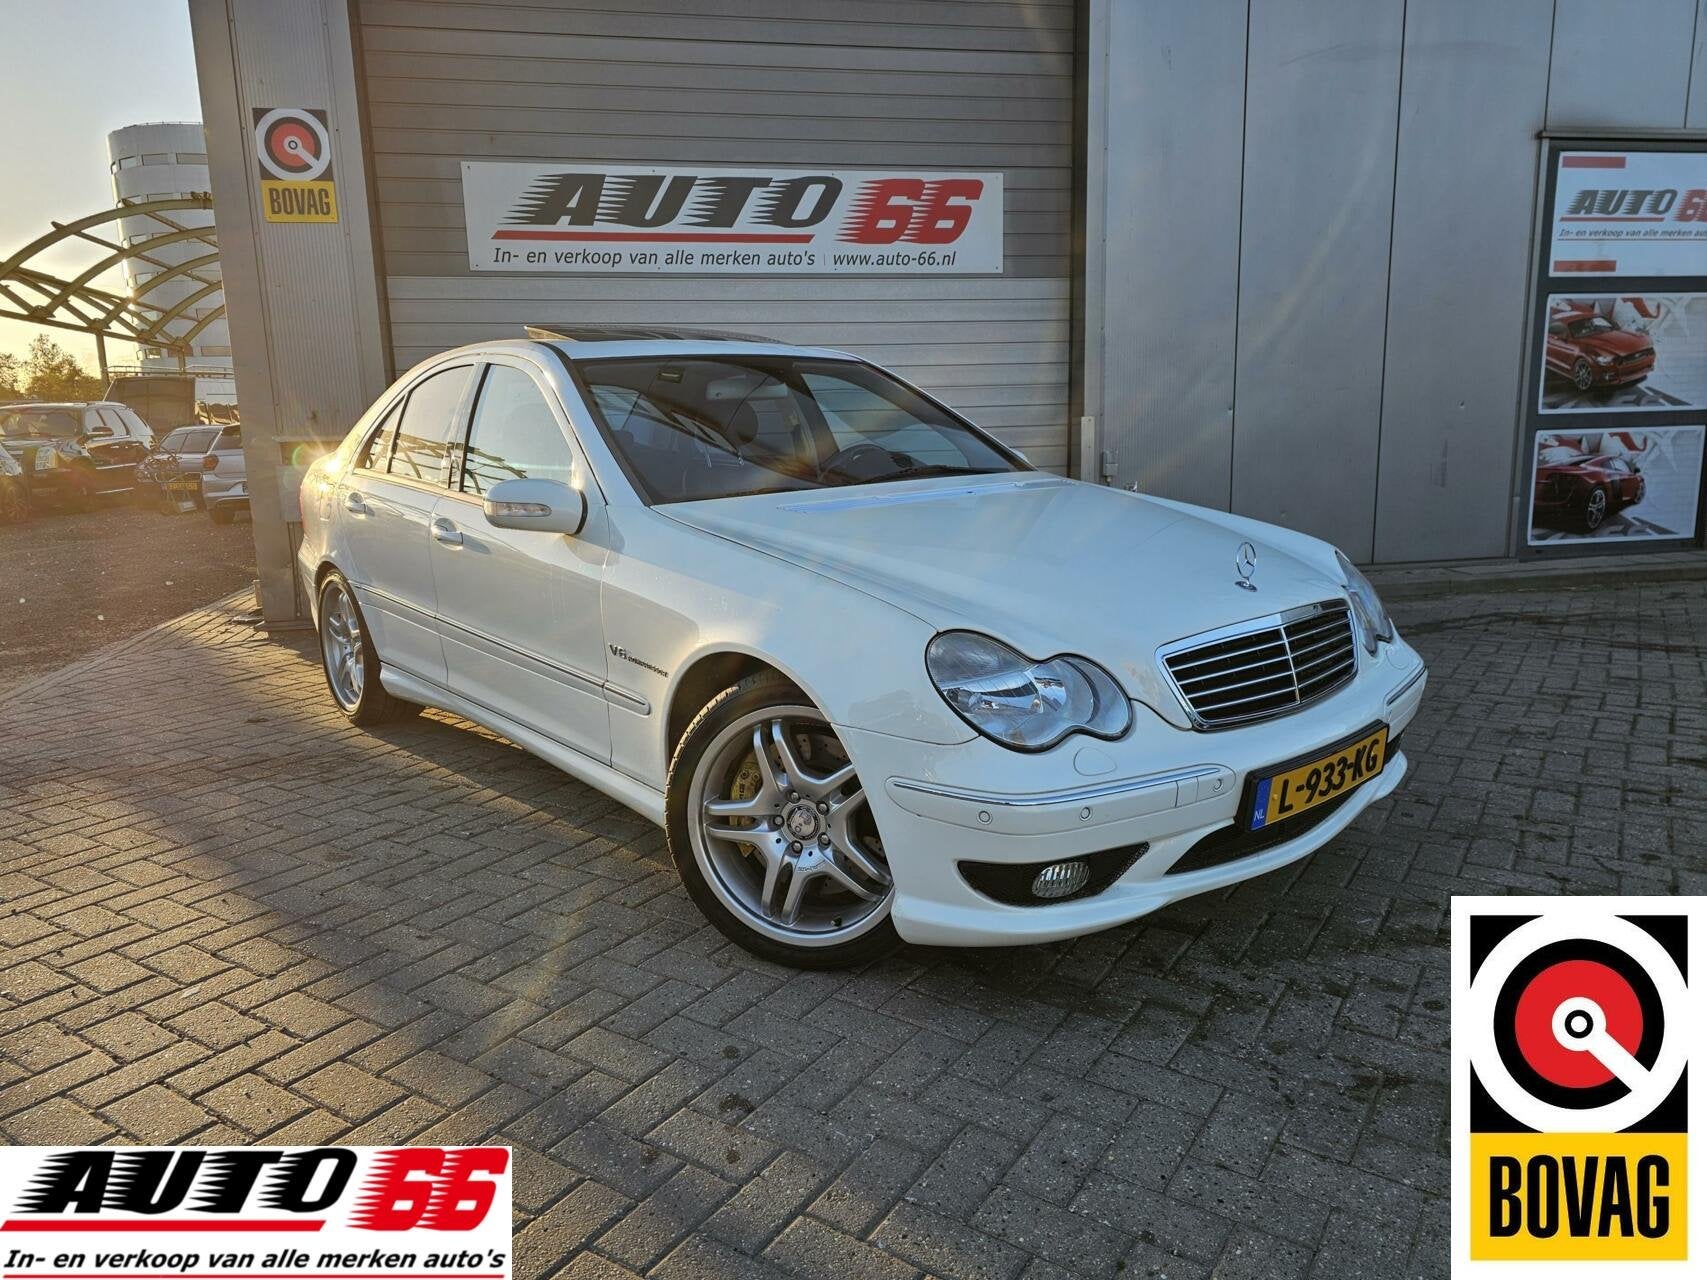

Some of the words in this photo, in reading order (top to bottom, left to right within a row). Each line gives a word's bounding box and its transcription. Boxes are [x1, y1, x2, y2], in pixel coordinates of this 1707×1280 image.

[268, 187, 331, 216] BOVAG
[499, 173, 843, 228] AUTO
[835, 178, 984, 245] 66
[1567, 189, 1678, 216] AUTO
[1575, 229, 1586, 237] en
[1589, 228, 1624, 238] verkoop
[1642, 228, 1659, 237] alle
[1660, 228, 1692, 237] merken
[493, 247, 519, 263] In-
[526, 251, 547, 264] en
[554, 248, 622, 268] verkoop
[629, 252, 658, 265] van
[664, 250, 694, 266] alle
[700, 250, 760, 266] merken
[767, 250, 815, 266] auto's
[832, 251, 956, 267] www.auto-66.nl
[1253, 810, 1265, 822] NL
[1278, 738, 1380, 814] L-933-KG
